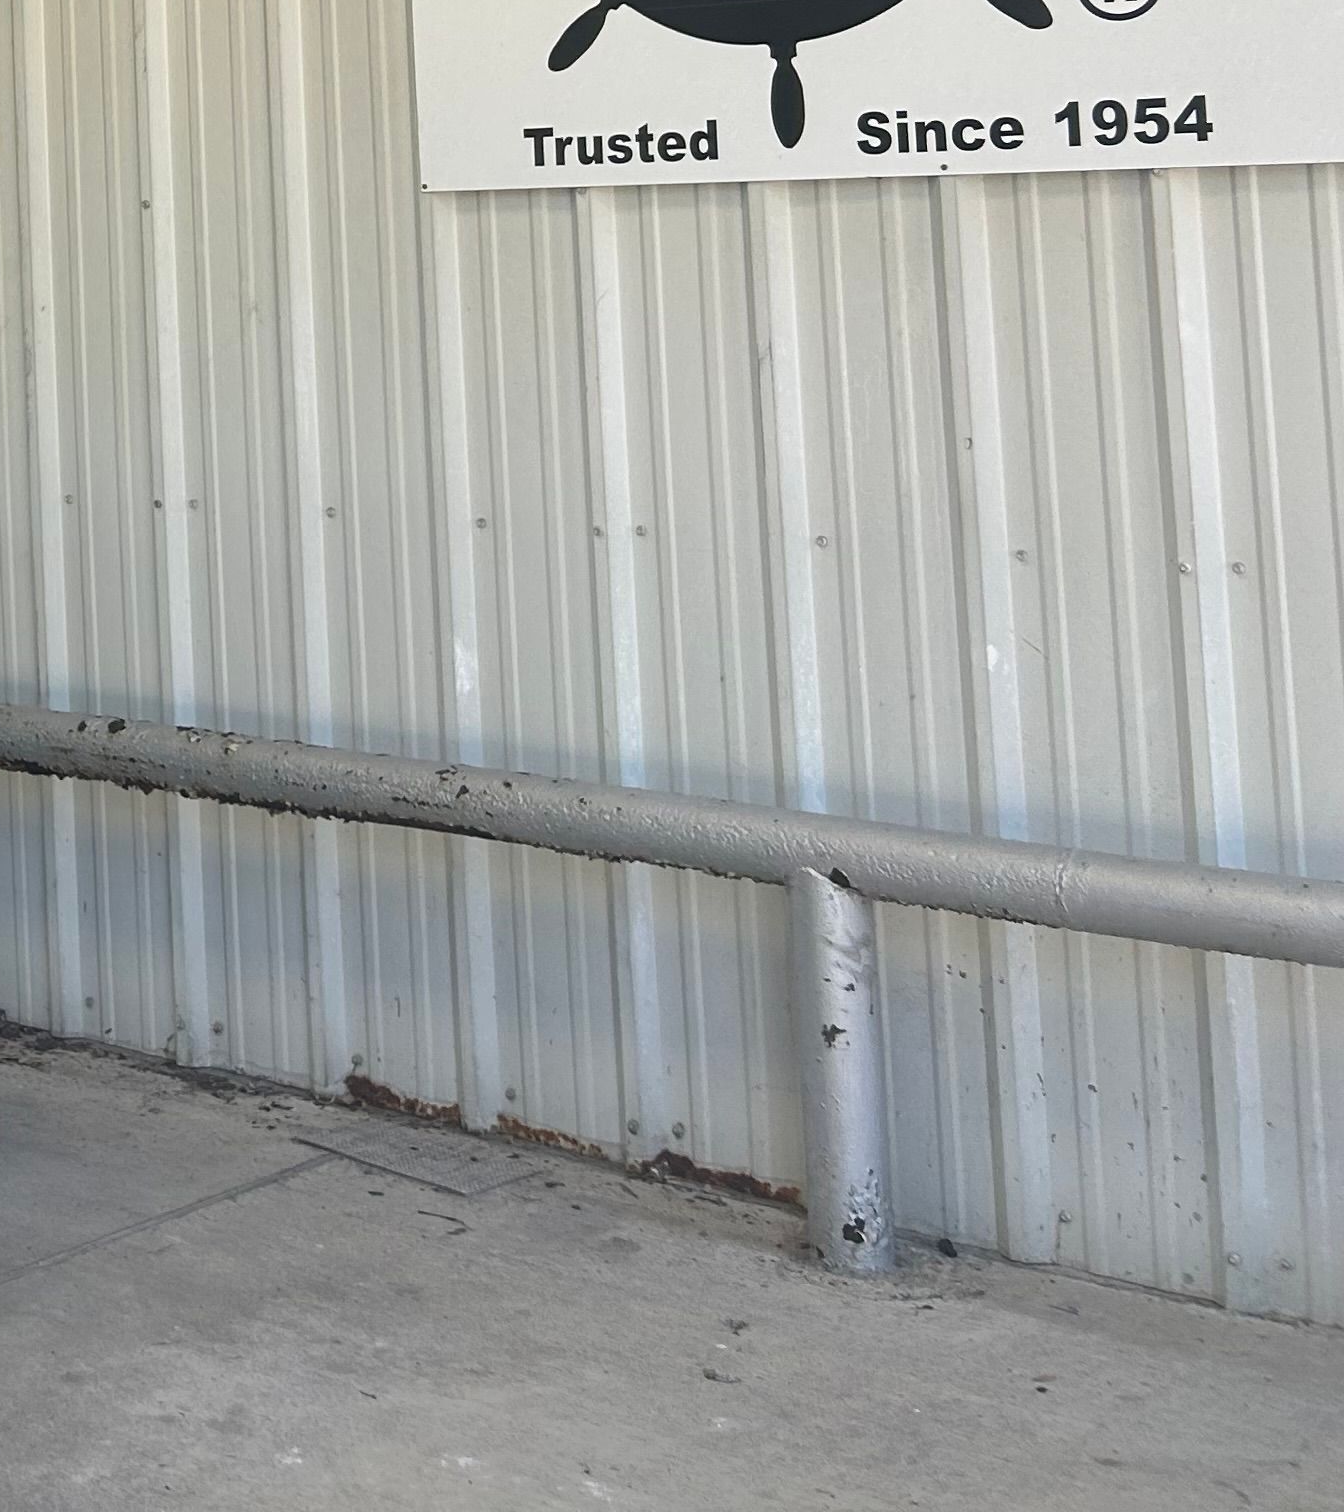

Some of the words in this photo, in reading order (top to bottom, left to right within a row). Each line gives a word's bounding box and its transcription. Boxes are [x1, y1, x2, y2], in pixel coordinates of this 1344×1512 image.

[523, 119, 719, 167] Trusted
[856, 109, 1025, 155] Since
[1054, 94, 1214, 147] 1954
